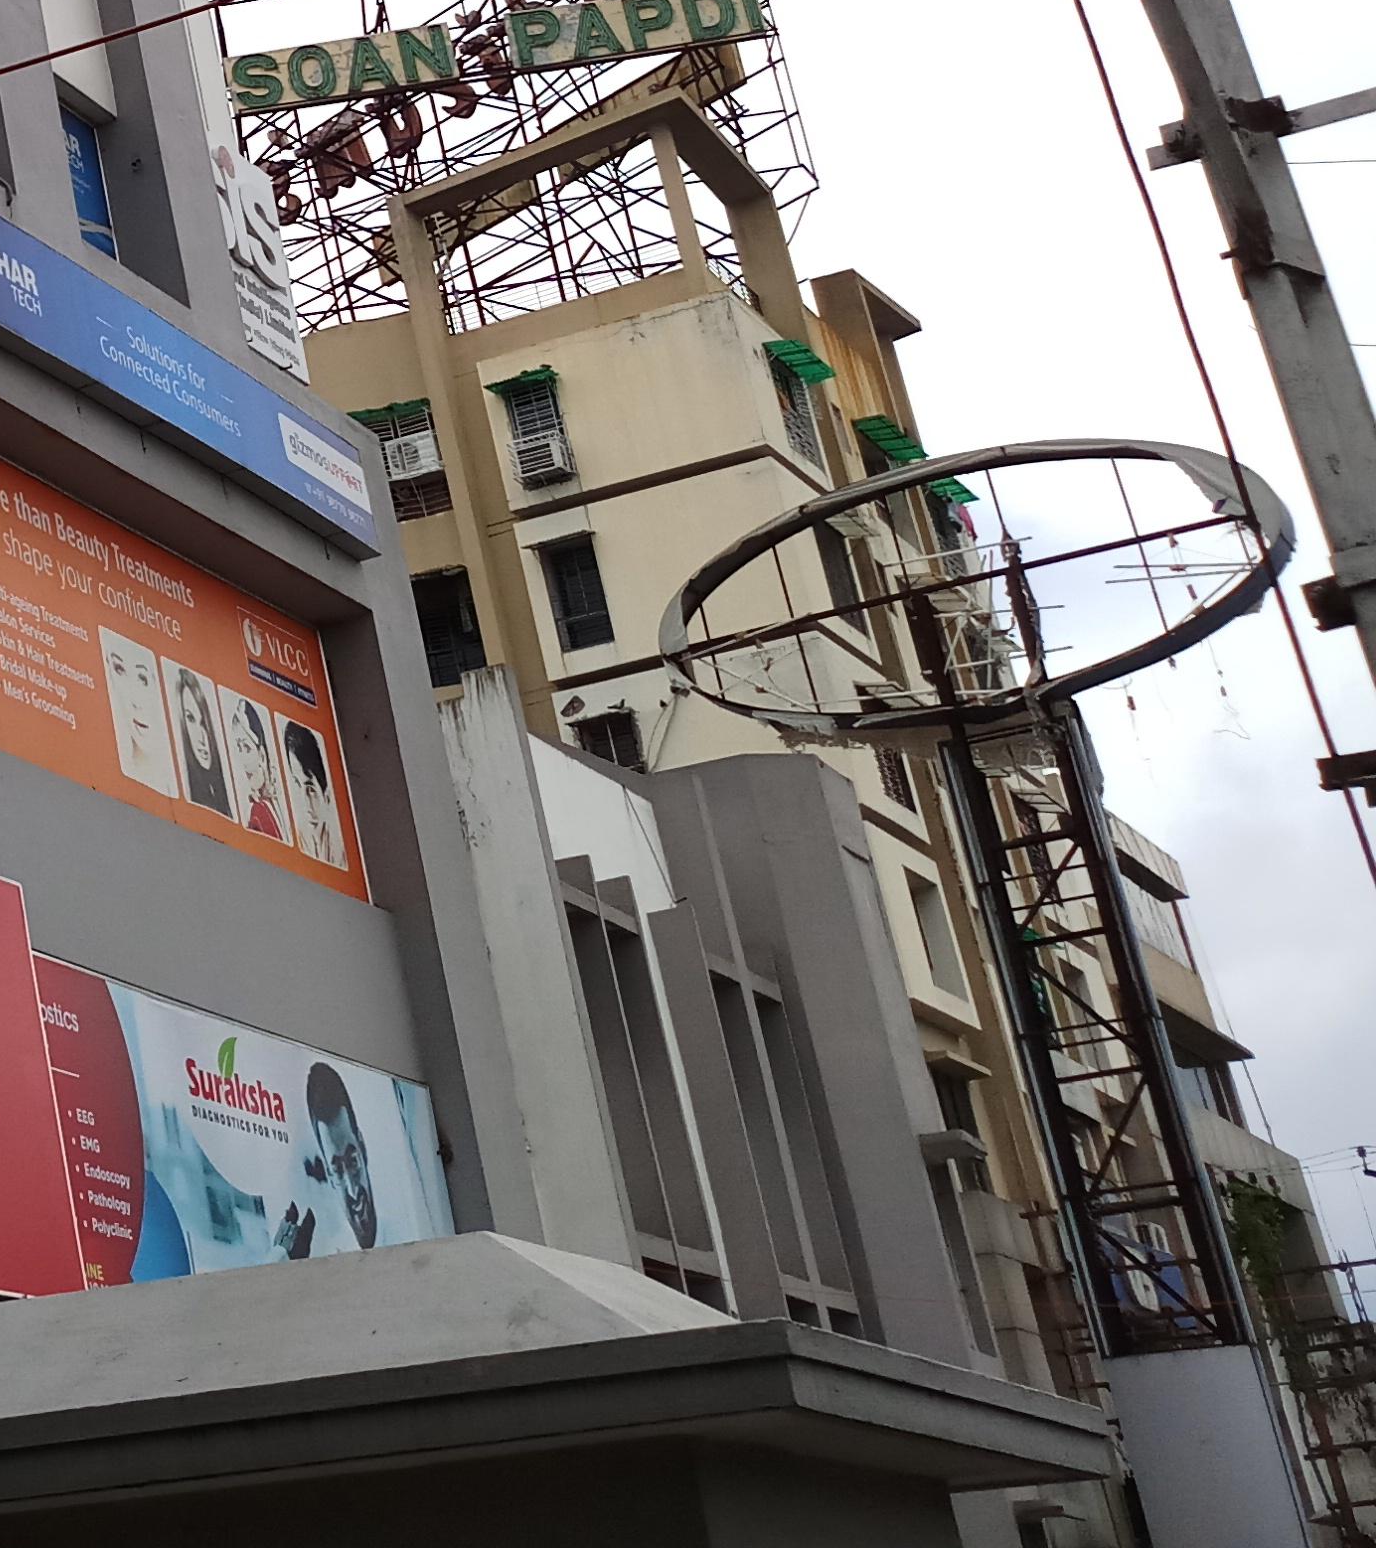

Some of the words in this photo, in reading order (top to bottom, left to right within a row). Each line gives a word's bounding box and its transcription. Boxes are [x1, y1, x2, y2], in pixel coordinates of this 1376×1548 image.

[231, 23, 457, 108] SOAN
[11, 285, 42, 318] TECH
[126, 326, 188, 383] Solutions
[188, 366, 207, 393] for
[100, 337, 171, 394] Connected
[173, 380, 242, 438] Consumers
[15, 491, 52, 533] than
[55, 512, 110, 572] Beauty
[111, 542, 196, 608] Treatments
[5, 526, 54, 578] shape
[57, 557, 93, 594] your
[98, 575, 183, 642] confidence
[18, 616, 56, 648] Services
[40, 605, 89, 642] Treatments
[45, 652, 95, 690] Treatments
[265, 632, 309, 677] VLCC
[0, 653, 27, 680] Bridal
[27, 665, 68, 702] Make-up
[2, 678, 30, 704] Men's
[31, 691, 77, 730] Grooming
[184, 1057, 287, 1123] Suraksha
[75, 1107, 96, 1127] EEG
[191, 1104, 251, 1135] DIAGNOSTICS
[252, 1121, 271, 1139] FOR
[272, 1127, 289, 1144] YOU
[79, 1134, 101, 1154] EMG
[83, 1162, 131, 1190] Endoscopy
[88, 1190, 132, 1217] Pathology
[91, 1217, 134, 1241] Polyclinic
